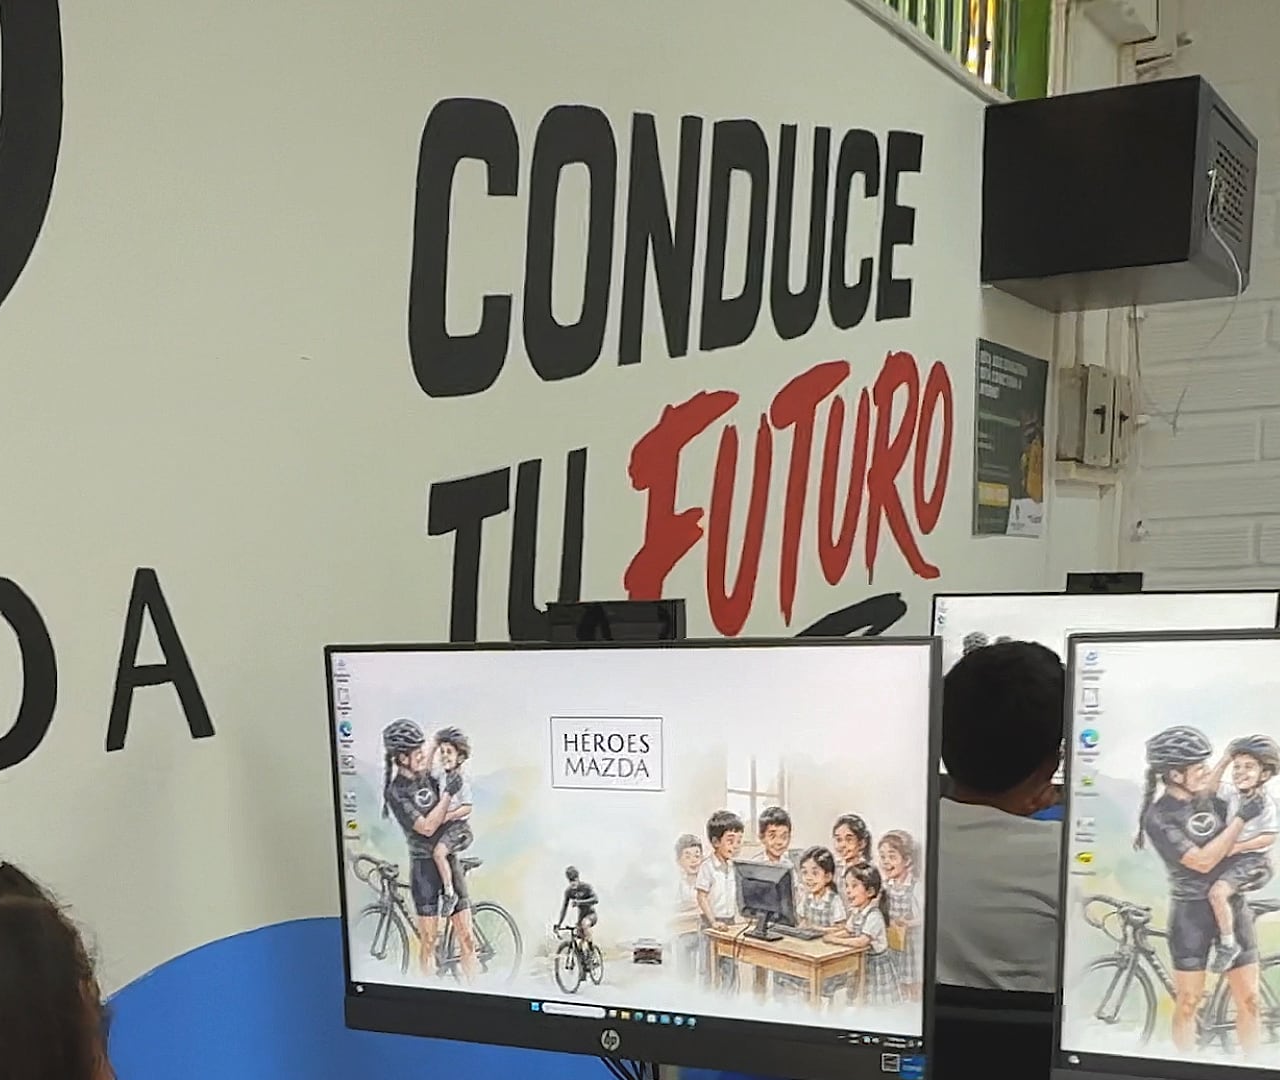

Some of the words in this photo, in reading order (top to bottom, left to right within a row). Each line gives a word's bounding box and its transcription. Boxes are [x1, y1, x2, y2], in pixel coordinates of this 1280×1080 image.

[409, 97, 924, 398] CONDUCE
[428, 447, 589, 641] TU
[623, 350, 953, 637] FUTURO
[563, 728, 651, 754] HÉROES
[564, 757, 650, 778] MAZDA
